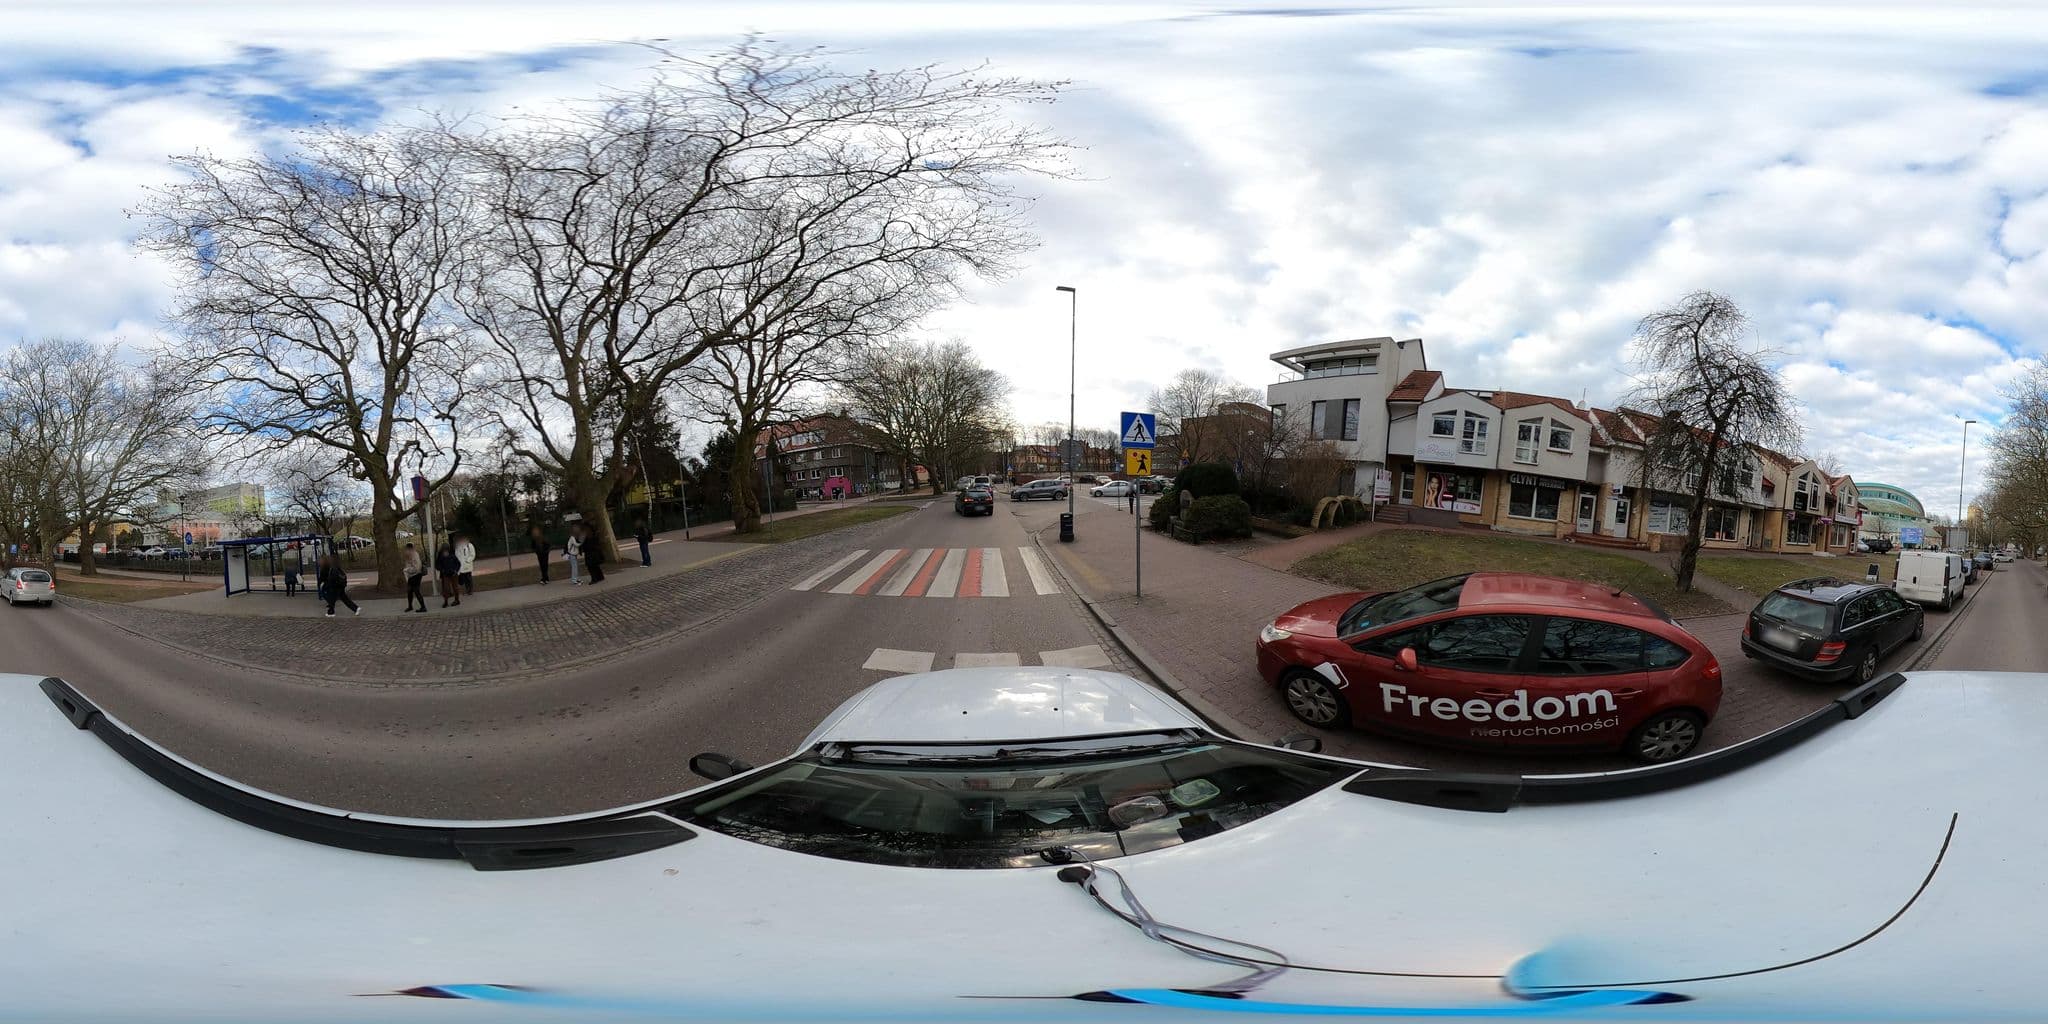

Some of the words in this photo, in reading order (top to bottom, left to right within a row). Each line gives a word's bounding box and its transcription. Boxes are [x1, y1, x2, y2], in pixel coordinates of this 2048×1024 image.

[1510, 473, 1537, 486] GLYNT
[1379, 682, 1617, 722] Freedom
[1470, 716, 1619, 737] nieruchomości
